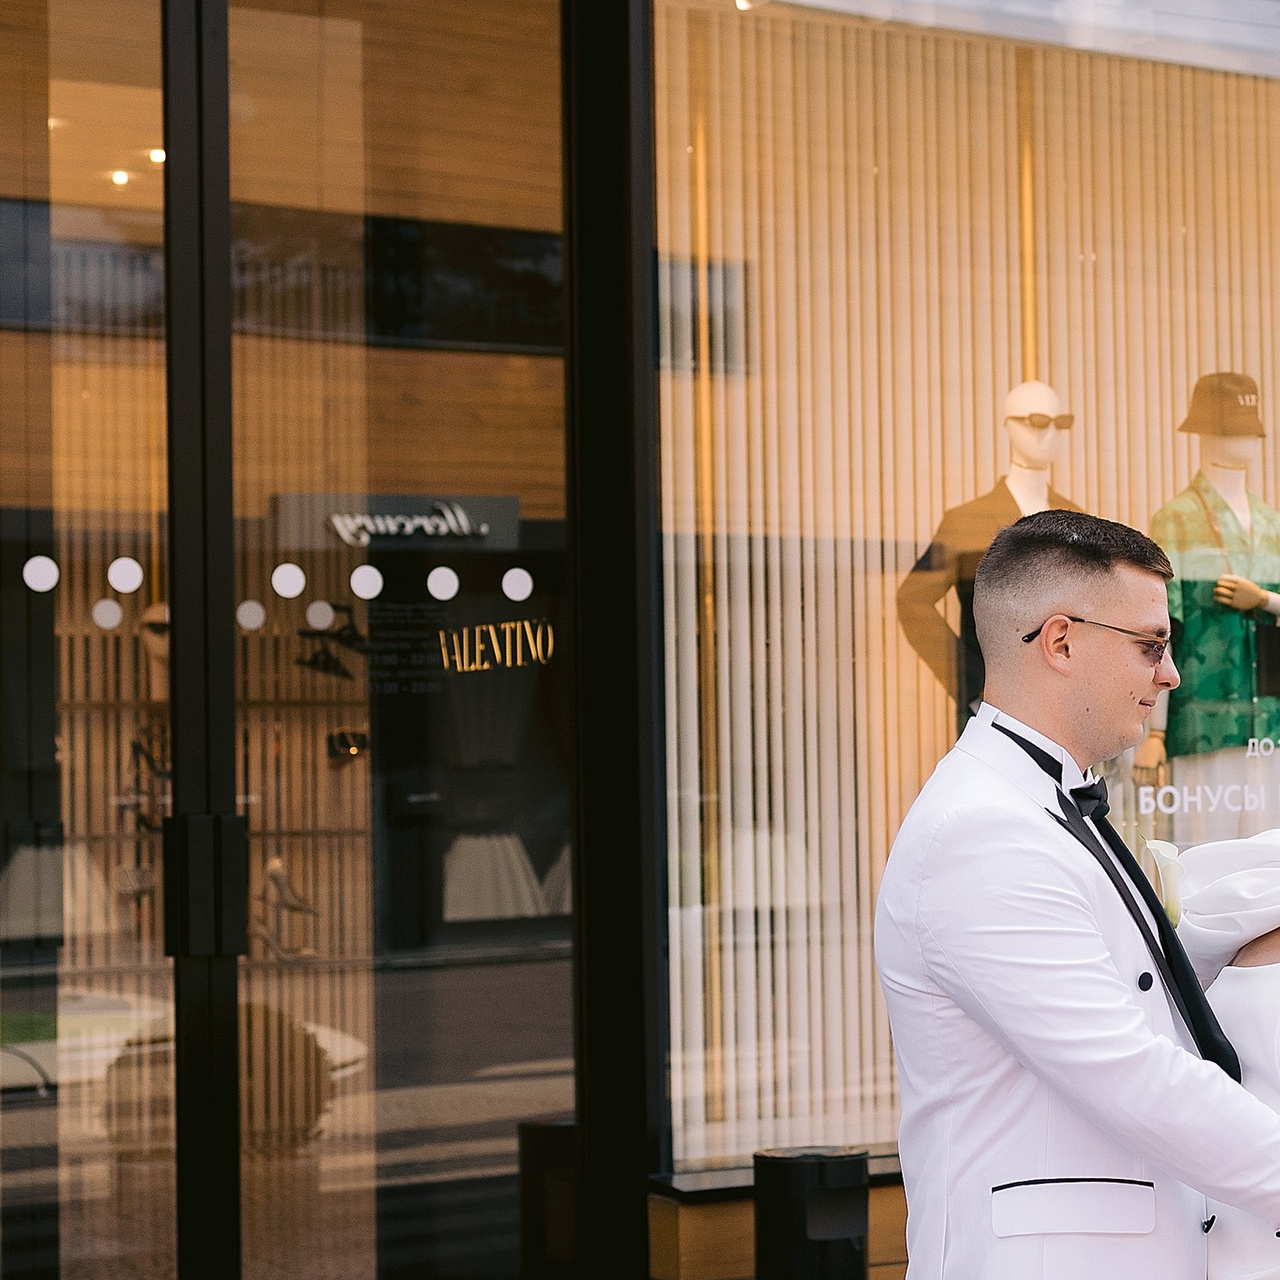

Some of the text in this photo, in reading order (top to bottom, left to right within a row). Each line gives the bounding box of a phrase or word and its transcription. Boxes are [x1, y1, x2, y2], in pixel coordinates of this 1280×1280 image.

[438, 618, 555, 673] VALENTINO
[1245, 737, 1275, 759] ДО
[1139, 785, 1266, 816] БОНУСЫ
